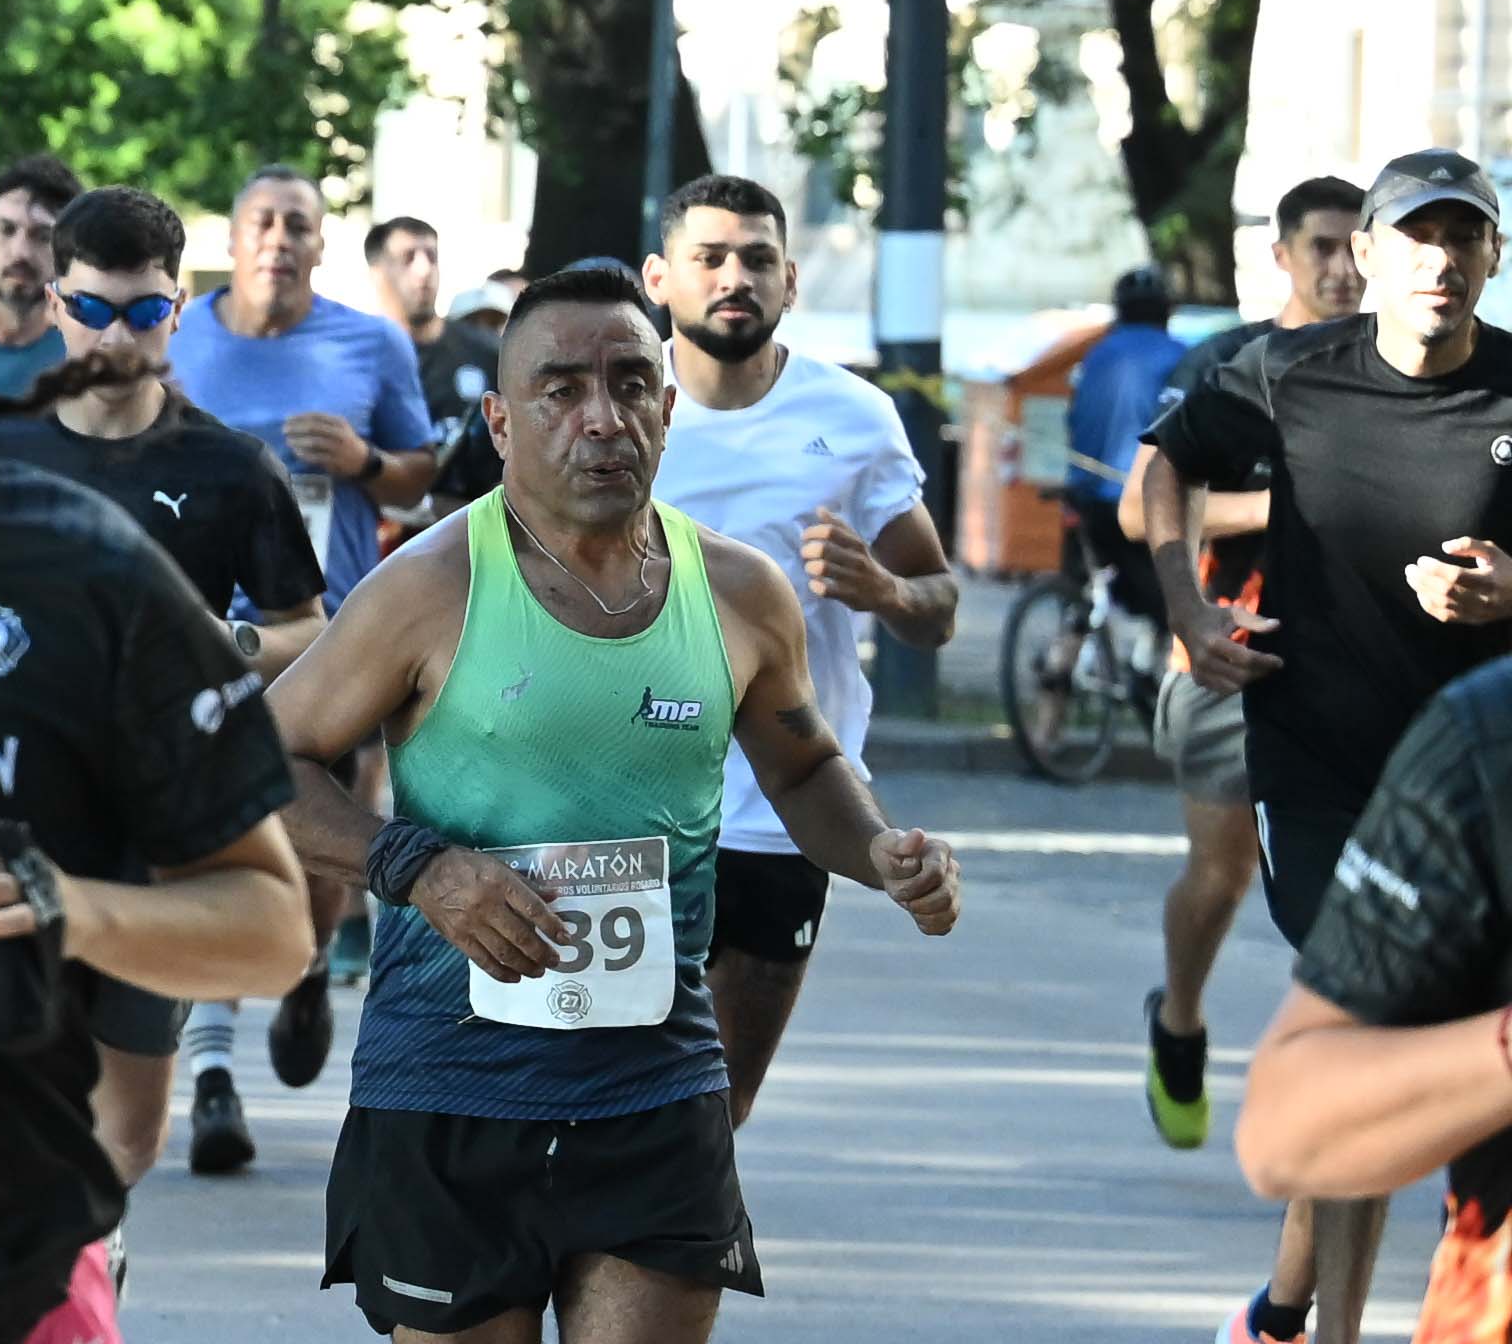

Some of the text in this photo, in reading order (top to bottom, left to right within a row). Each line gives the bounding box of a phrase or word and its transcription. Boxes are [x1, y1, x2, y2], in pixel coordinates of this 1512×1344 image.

[647, 700, 702, 722] MP
[527, 847, 643, 881] MARATÓN
[575, 881, 629, 896] VOLUNTARIOS
